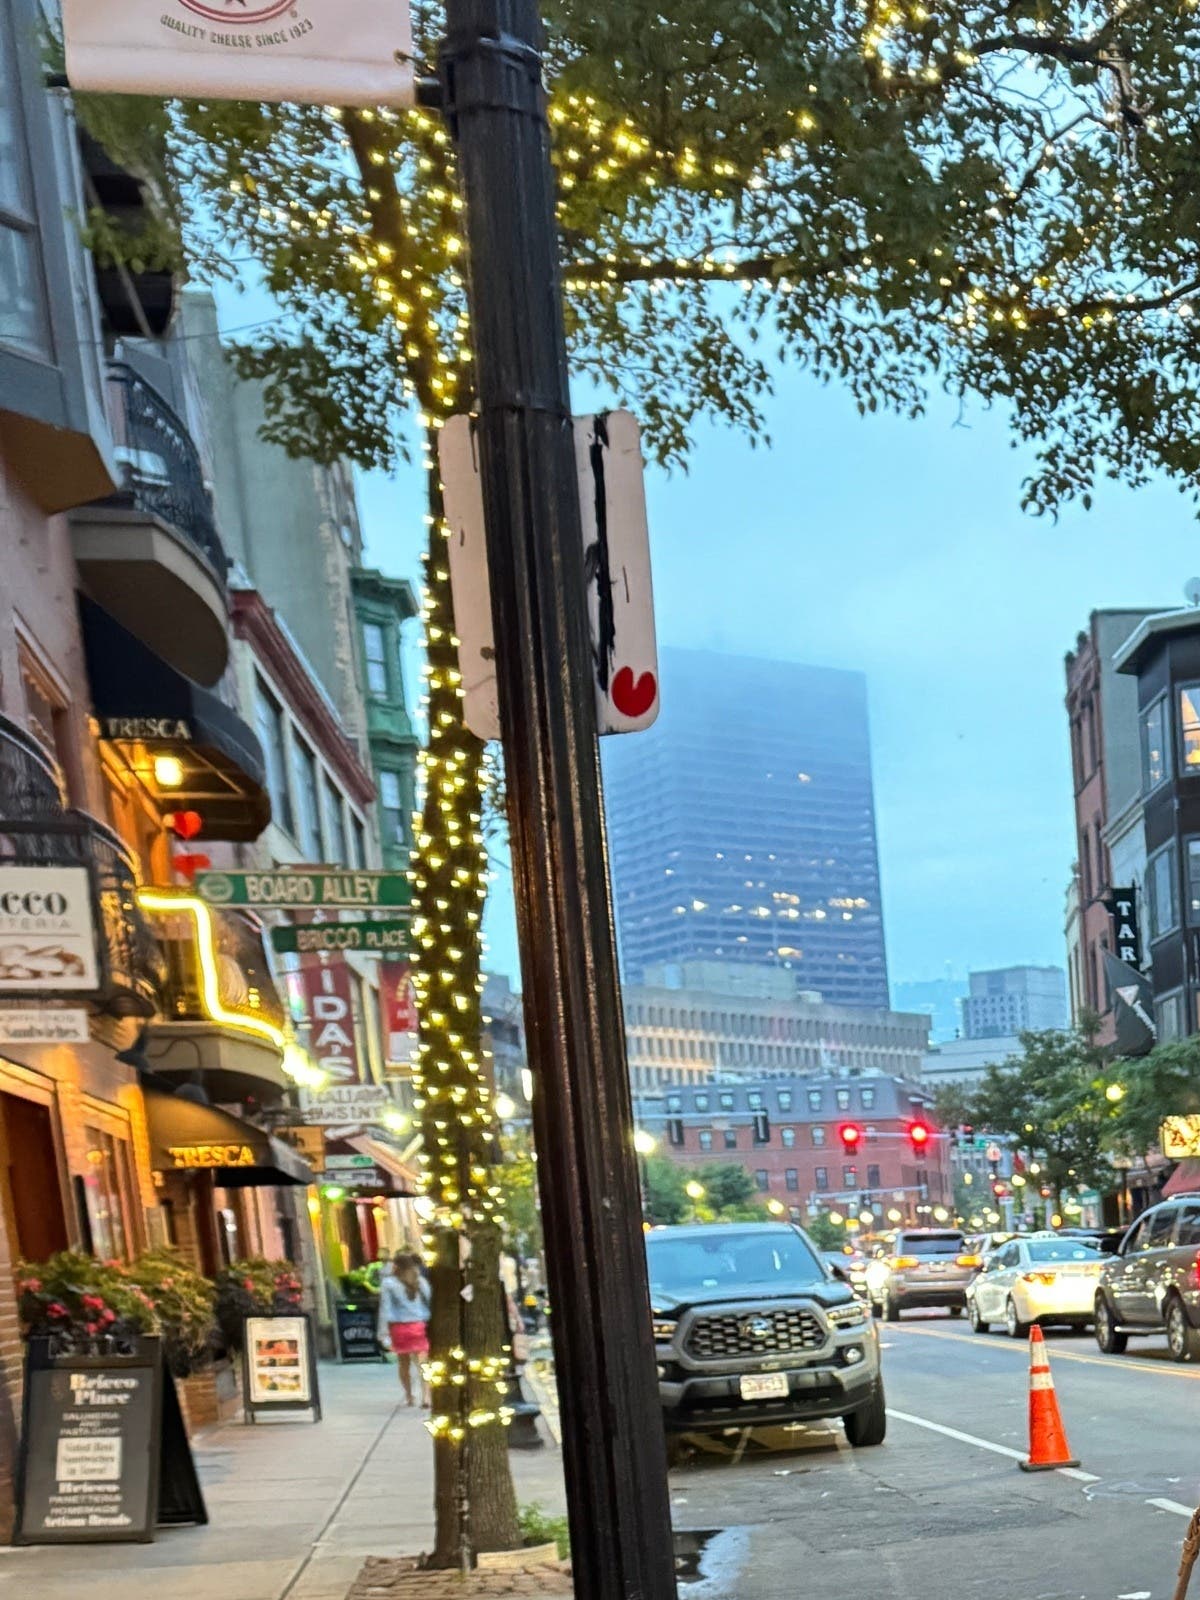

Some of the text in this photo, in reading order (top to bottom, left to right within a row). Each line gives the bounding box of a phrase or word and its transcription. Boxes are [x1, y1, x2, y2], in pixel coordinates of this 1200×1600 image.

[160, 14, 314, 48] QUALITY CHEESE SINCE 1923
[109, 718, 192, 739] TRESCA
[245, 876, 380, 903] BOARD ALLEY
[297, 928, 406, 950] BRICCO PLACE
[168, 1145, 255, 1168] TRESCA
[69, 1373, 139, 1390] Bricco
